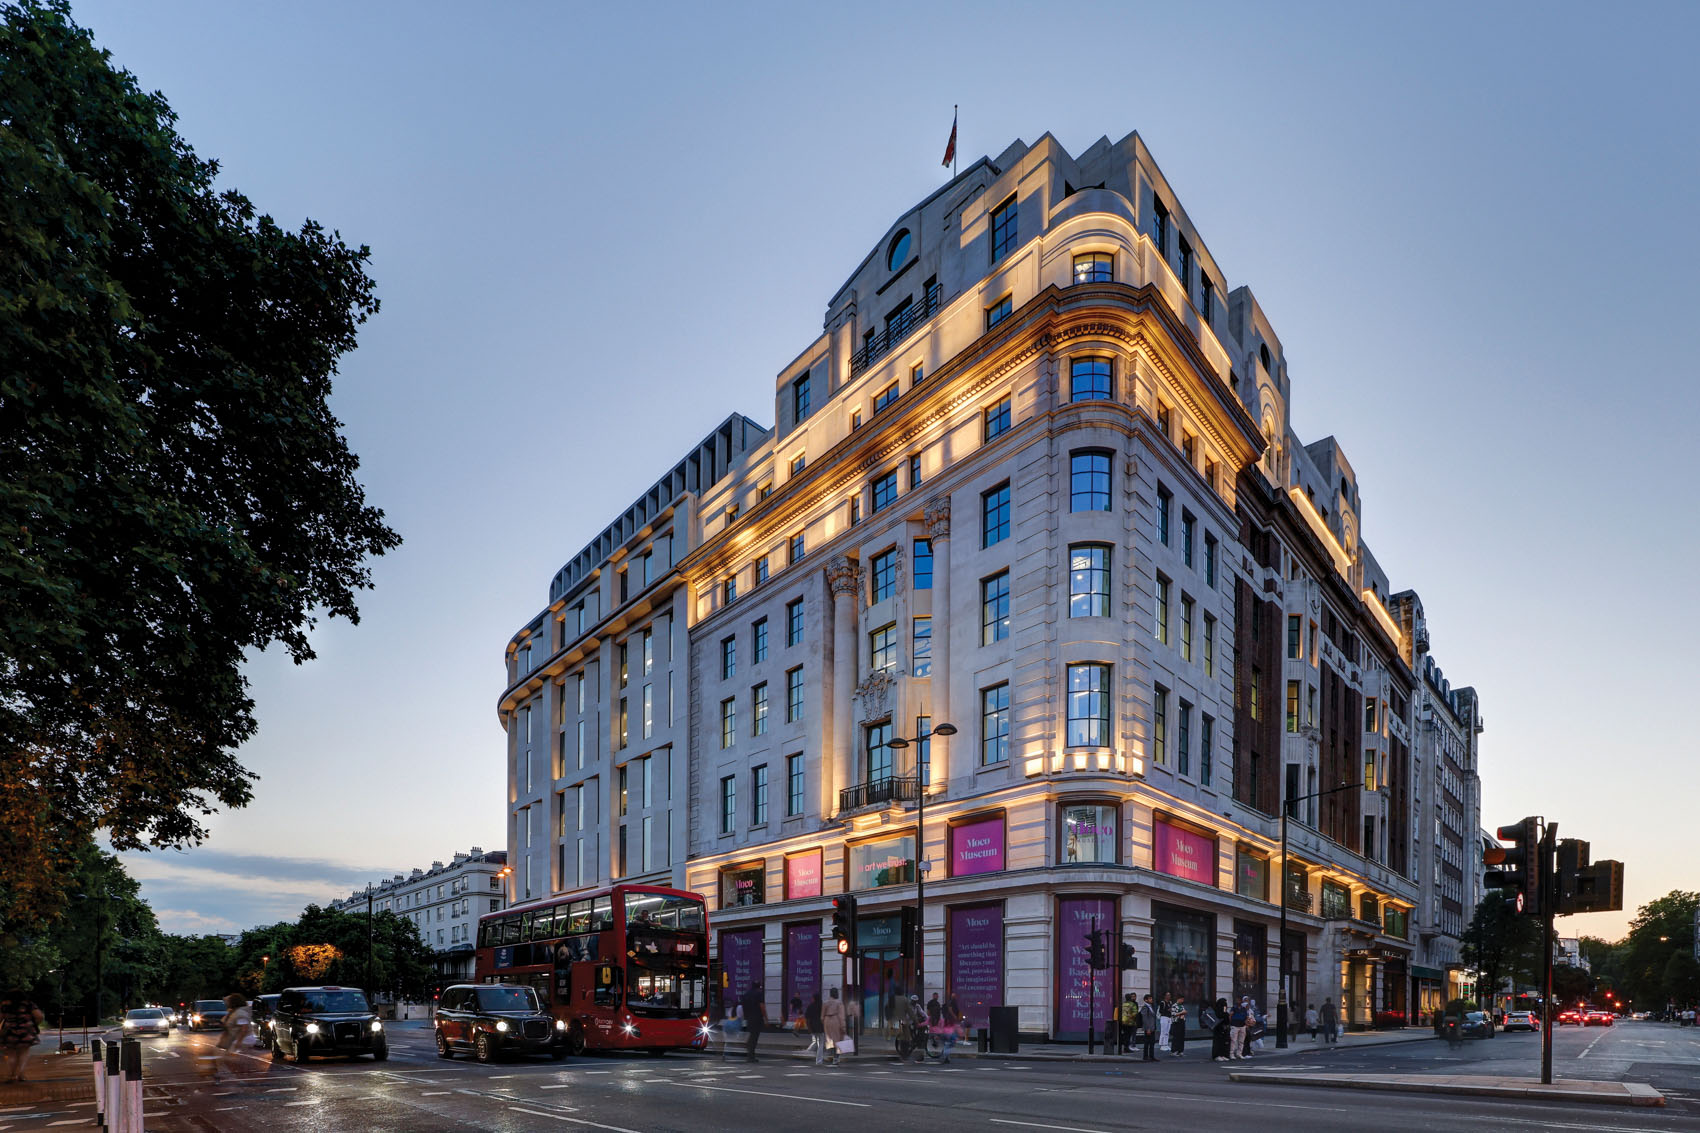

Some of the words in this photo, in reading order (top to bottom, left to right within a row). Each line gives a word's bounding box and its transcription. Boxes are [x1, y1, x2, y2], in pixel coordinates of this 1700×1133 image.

[966, 838, 991, 849] Moco
[1176, 838, 1194, 856] Moco
[960, 848, 998, 861] Museum
[864, 862, 876, 872] art
[876, 860, 888, 871] we
[1171, 852, 1198, 872] Museum
[735, 879, 753, 889] Moco
[1073, 910, 1105, 921] Moco
[966, 918, 990, 928] Moco
[872, 927, 892, 936] Moco
